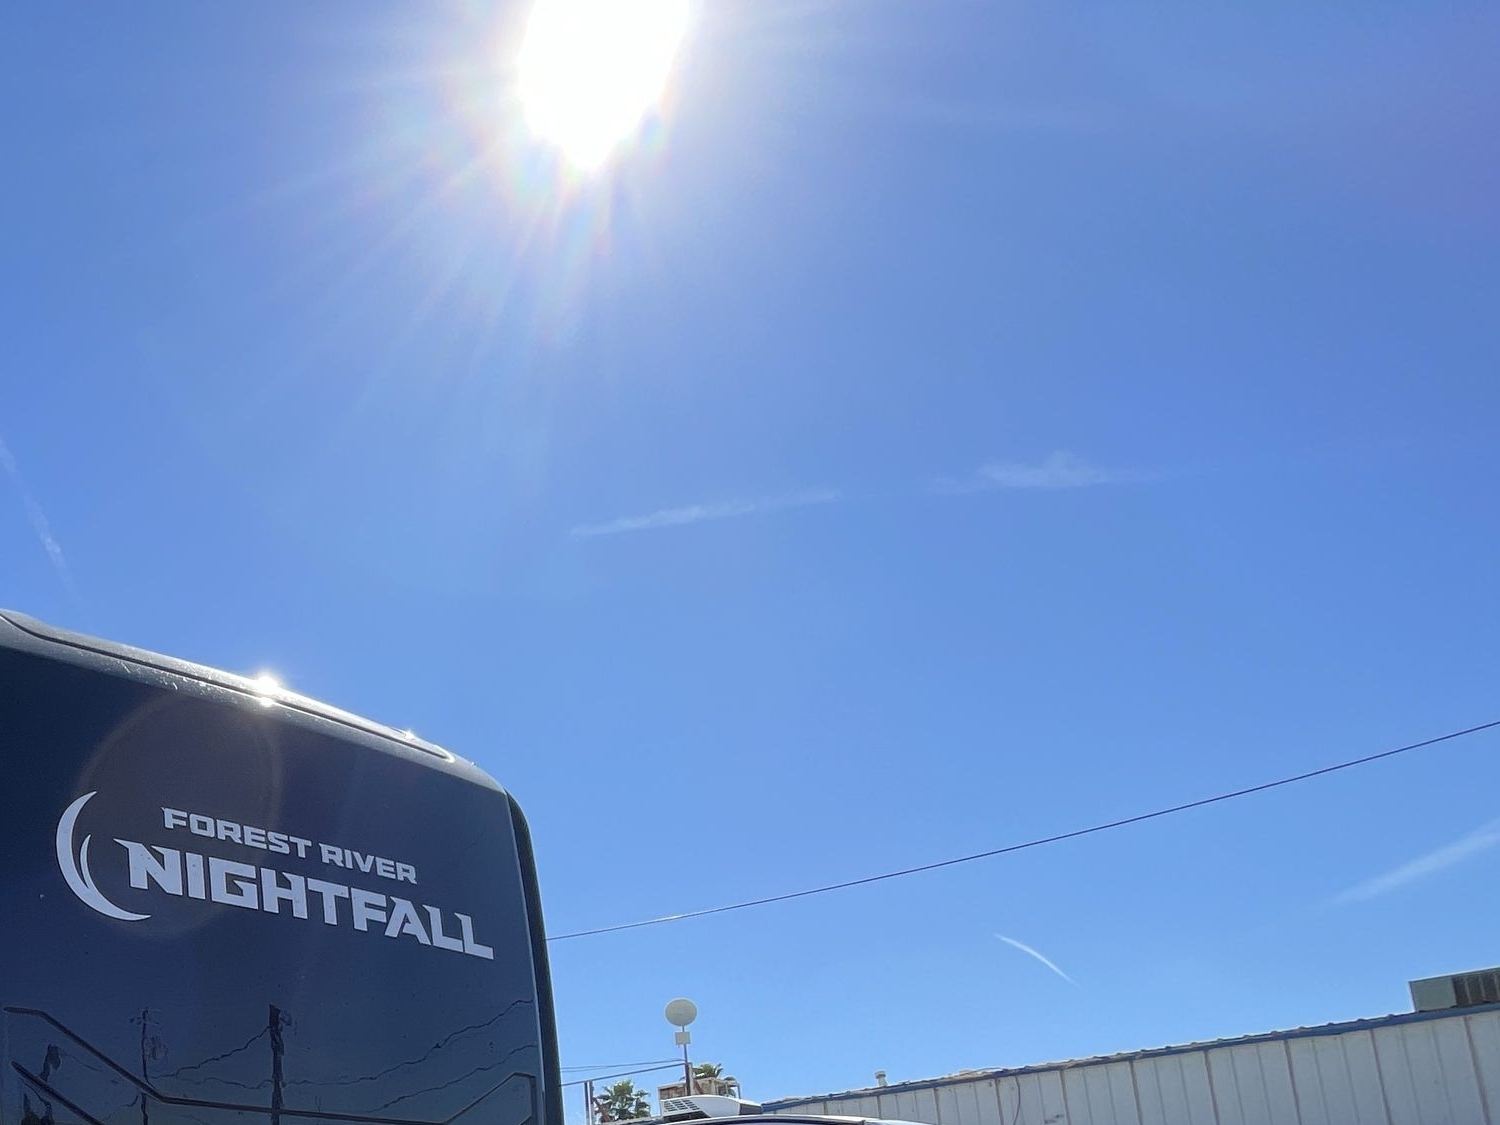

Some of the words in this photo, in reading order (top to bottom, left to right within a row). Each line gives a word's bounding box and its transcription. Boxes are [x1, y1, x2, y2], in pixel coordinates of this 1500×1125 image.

[161, 807, 312, 859] FOREST
[318, 842, 418, 884] RIVER
[113, 838, 494, 960] NIGHTFALL
